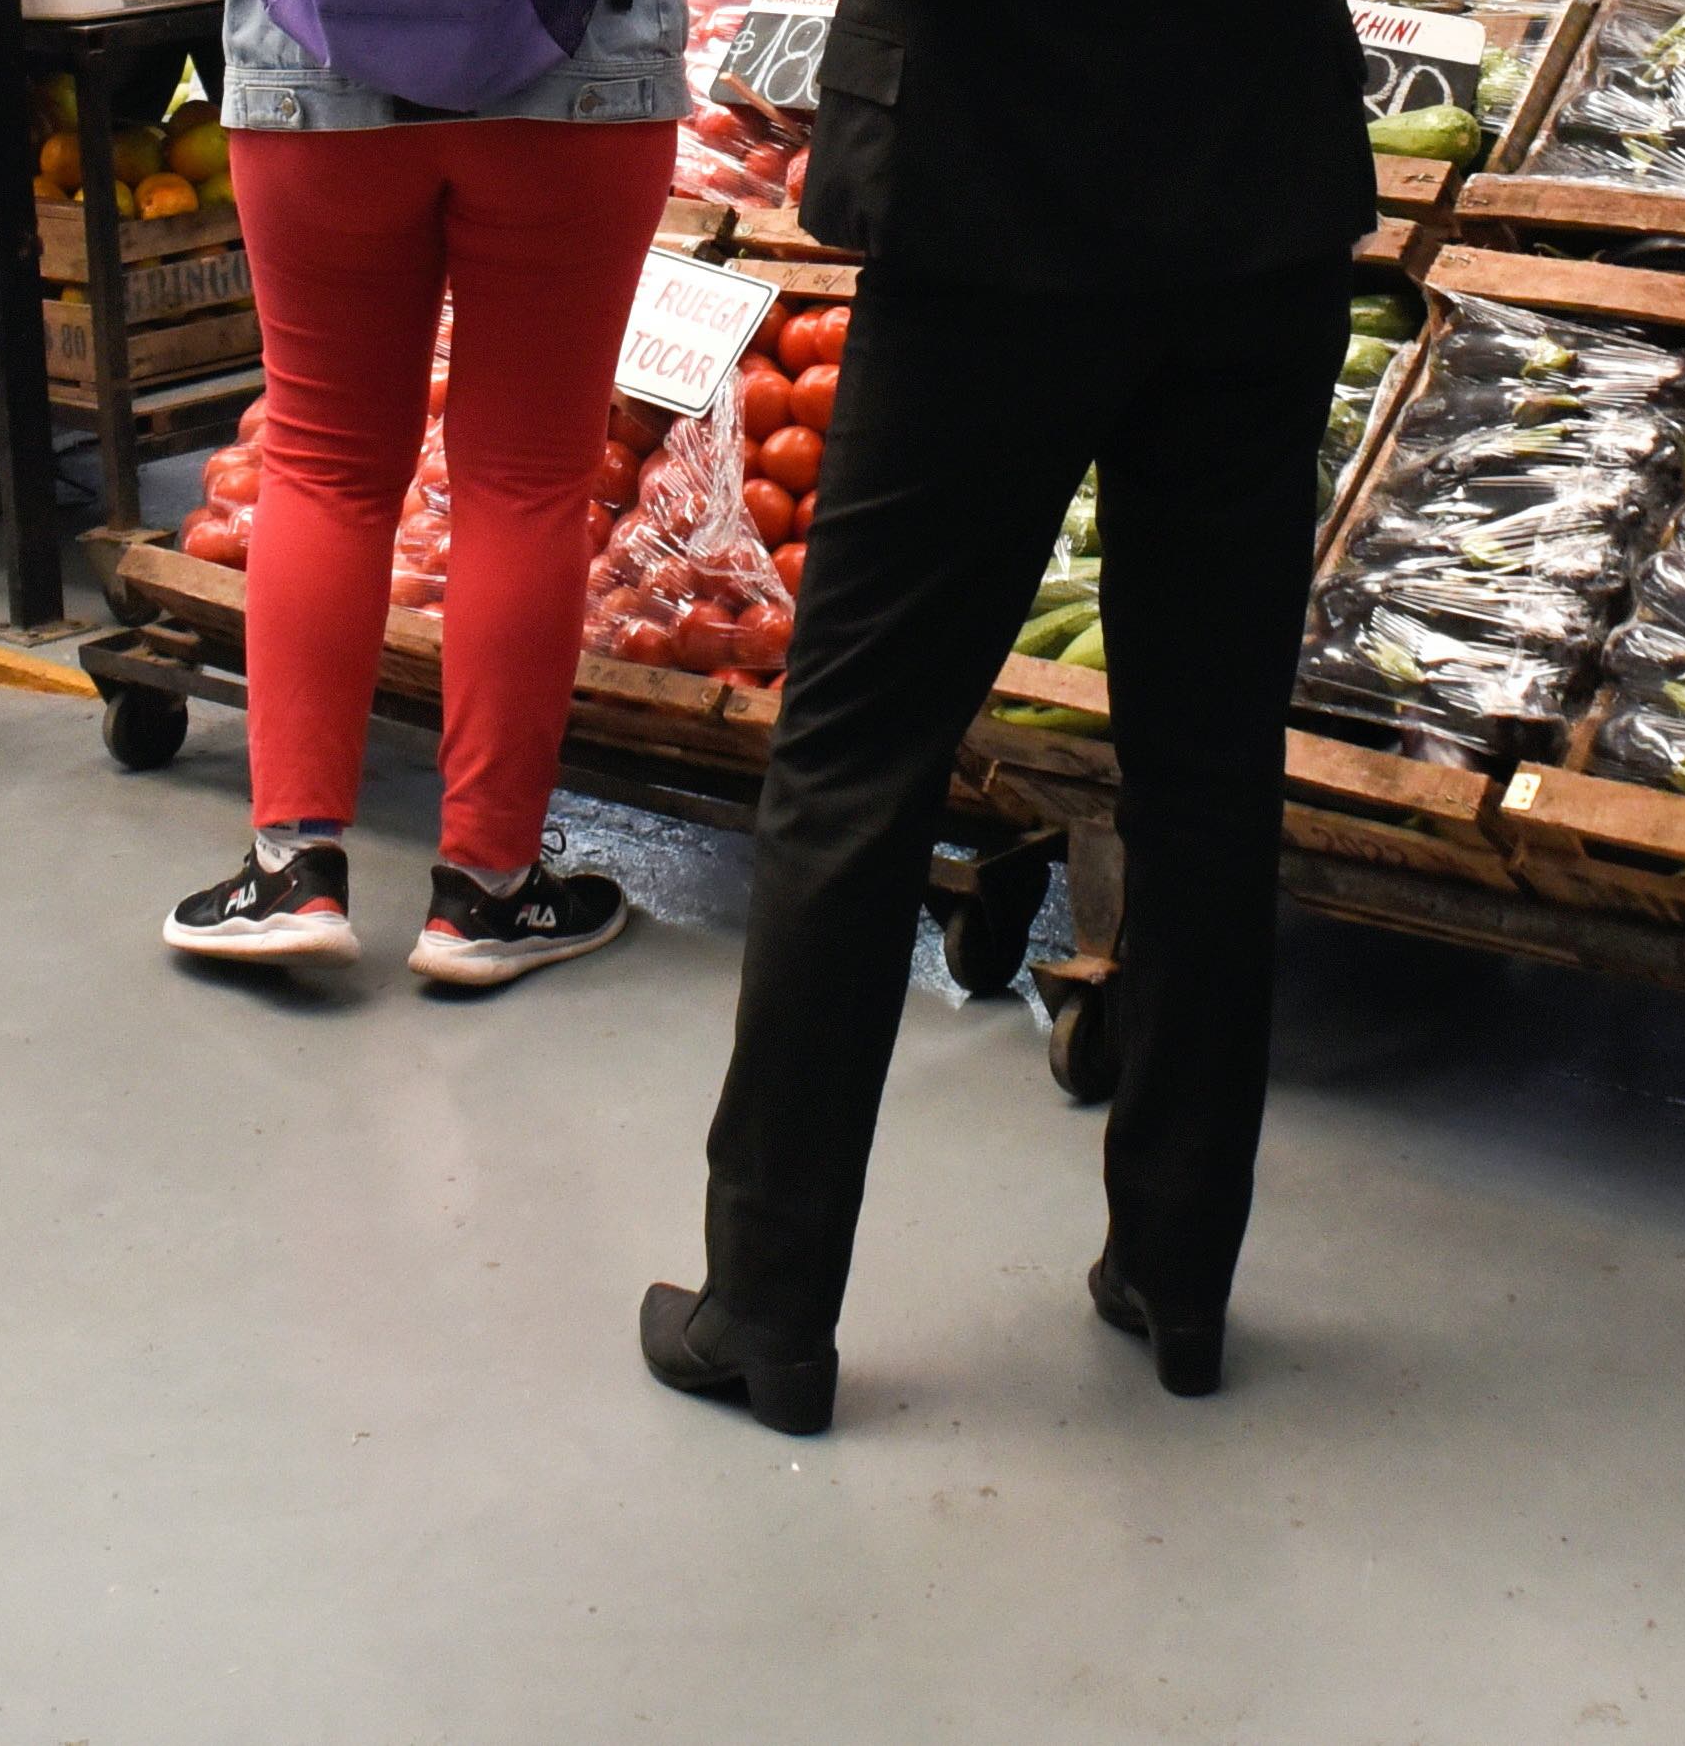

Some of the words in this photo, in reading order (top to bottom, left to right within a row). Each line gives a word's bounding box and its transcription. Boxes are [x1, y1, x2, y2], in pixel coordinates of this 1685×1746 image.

[1352, 10, 1422, 45] CHINI
[655, 277, 751, 341] RUEGA
[625, 330, 716, 380] TOCAR
[224, 881, 256, 915] FILA
[516, 905, 558, 929] FILA
